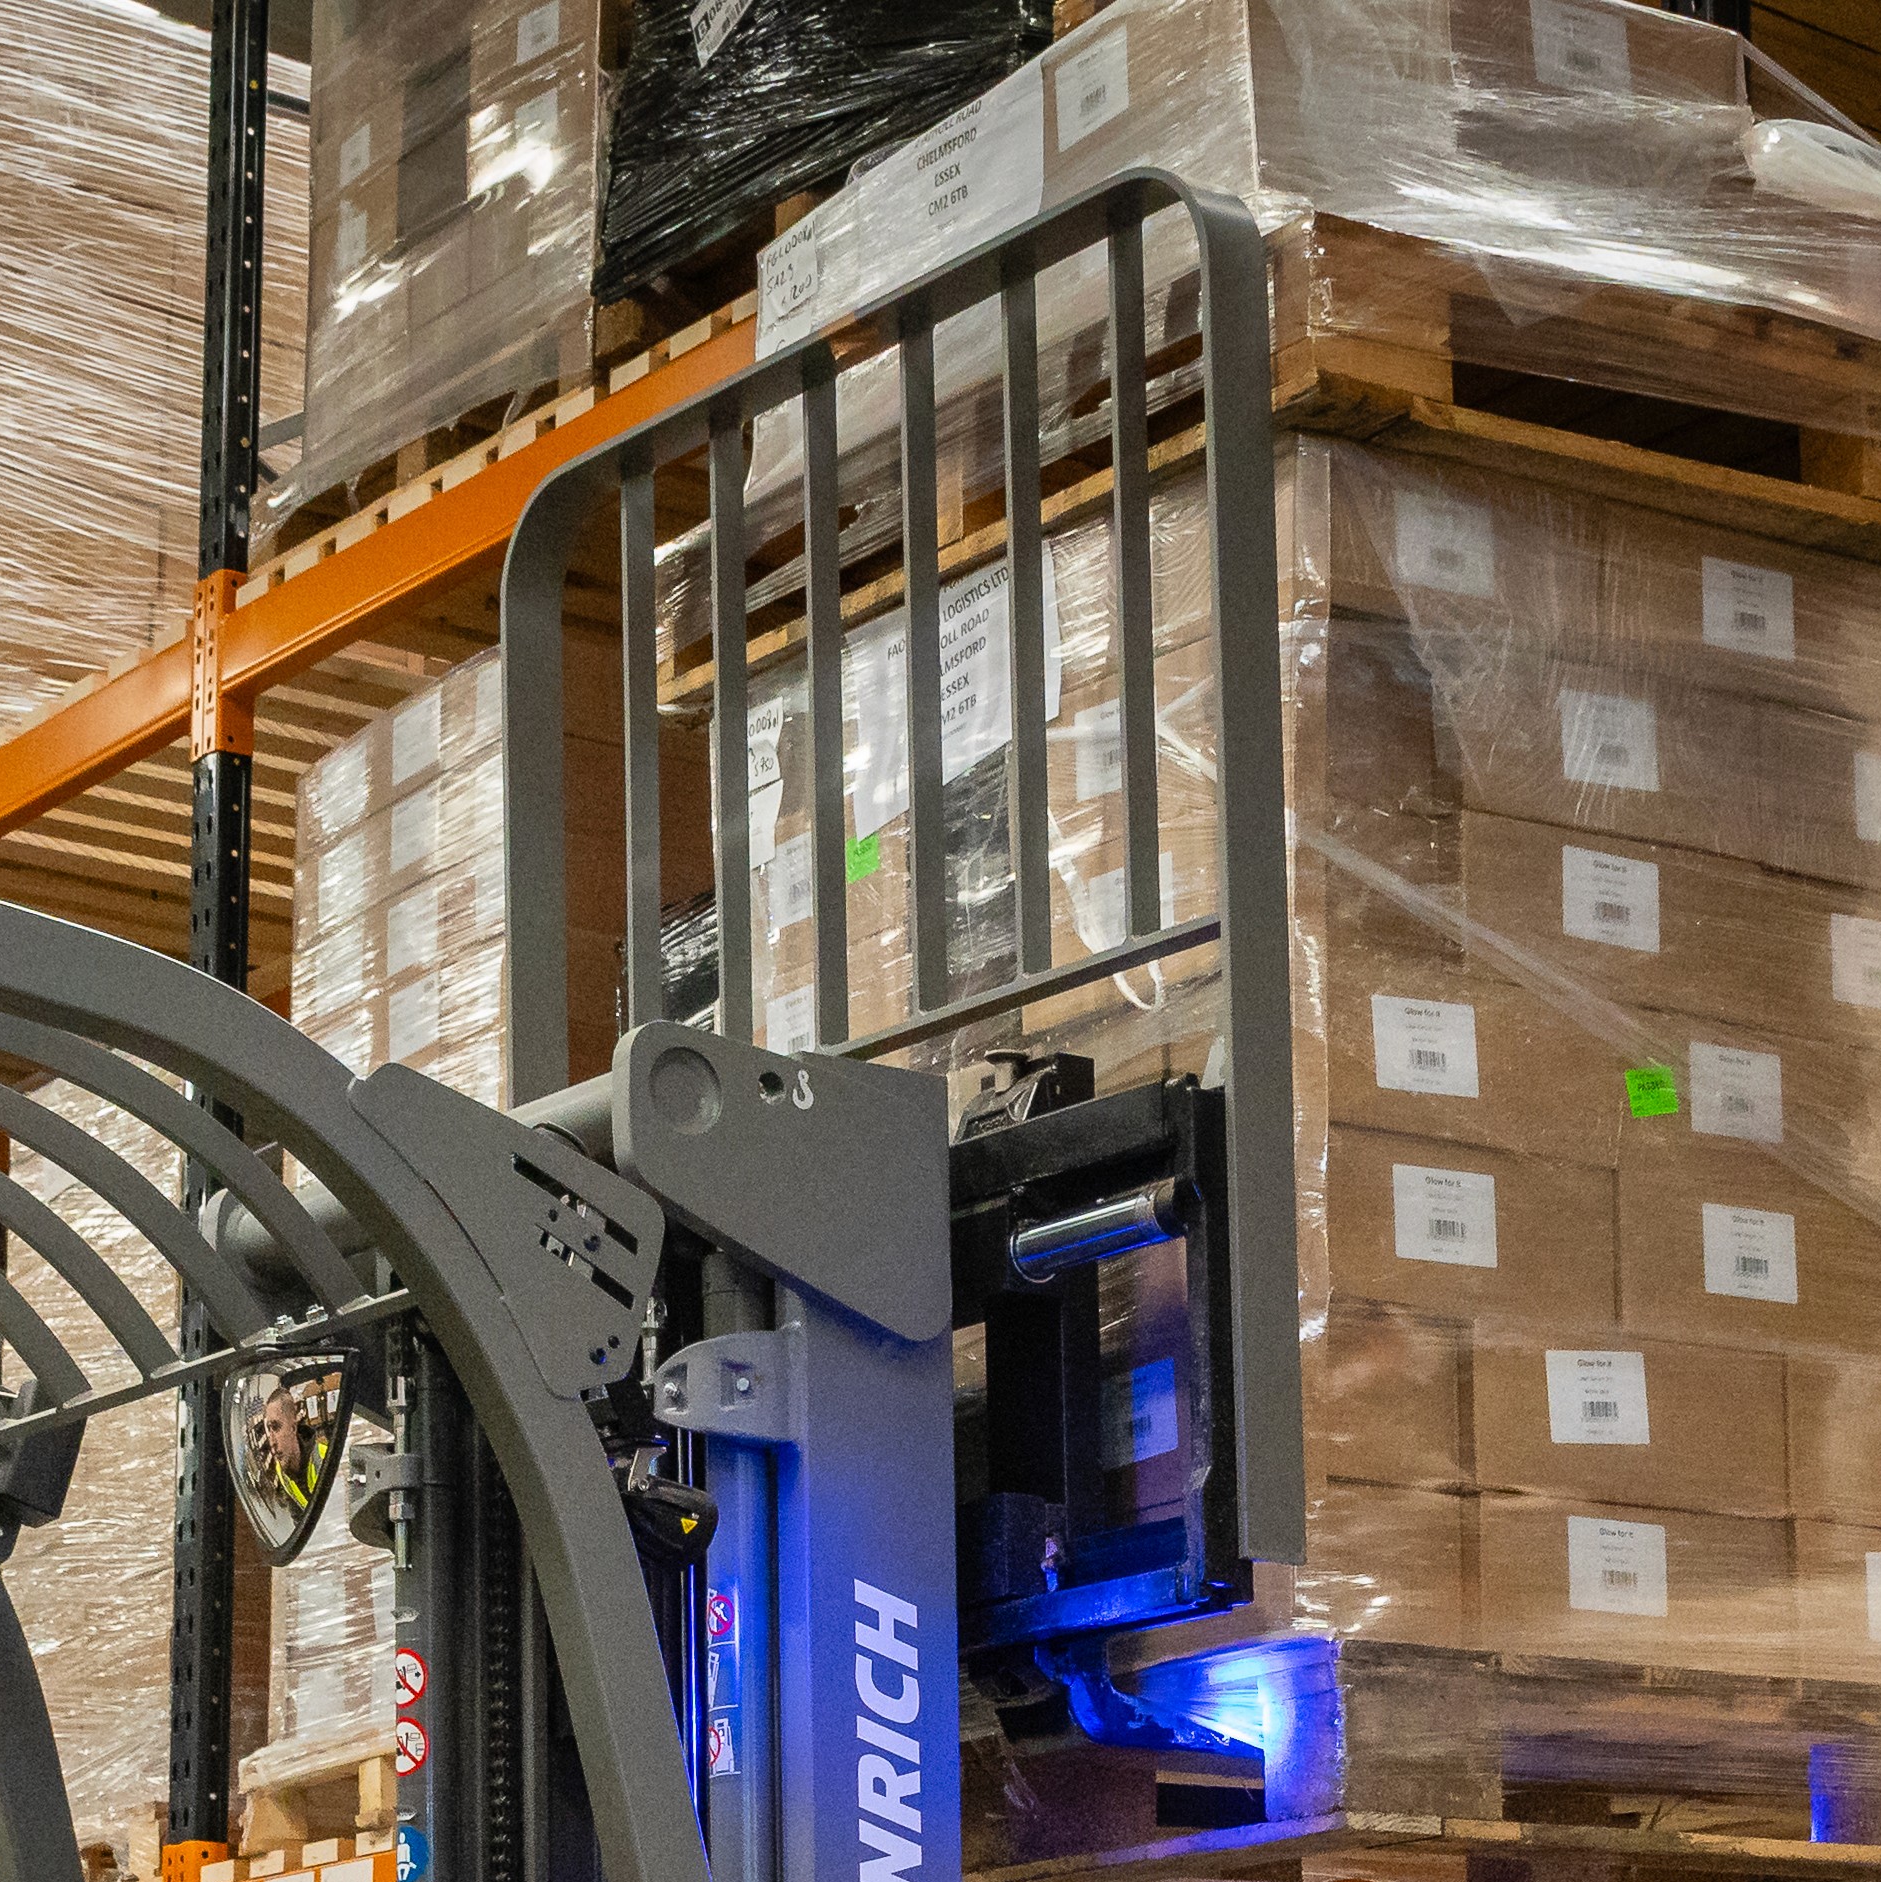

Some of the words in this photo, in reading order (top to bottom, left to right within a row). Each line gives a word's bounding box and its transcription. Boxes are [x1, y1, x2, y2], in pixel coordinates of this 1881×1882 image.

[917, 127, 977, 170] CHELMSFORD
[935, 162, 961, 187] ESSEX
[929, 194, 949, 216] CM2
[951, 184, 968, 204] 6TB
[943, 579, 991, 622] LOGISTICS
[990, 566, 1009, 589] LTD
[941, 629, 958, 650] OLL
[961, 608, 989, 636] ROAD
[940, 636, 986, 676] LMSFORD
[958, 694, 976, 714] 6TB
